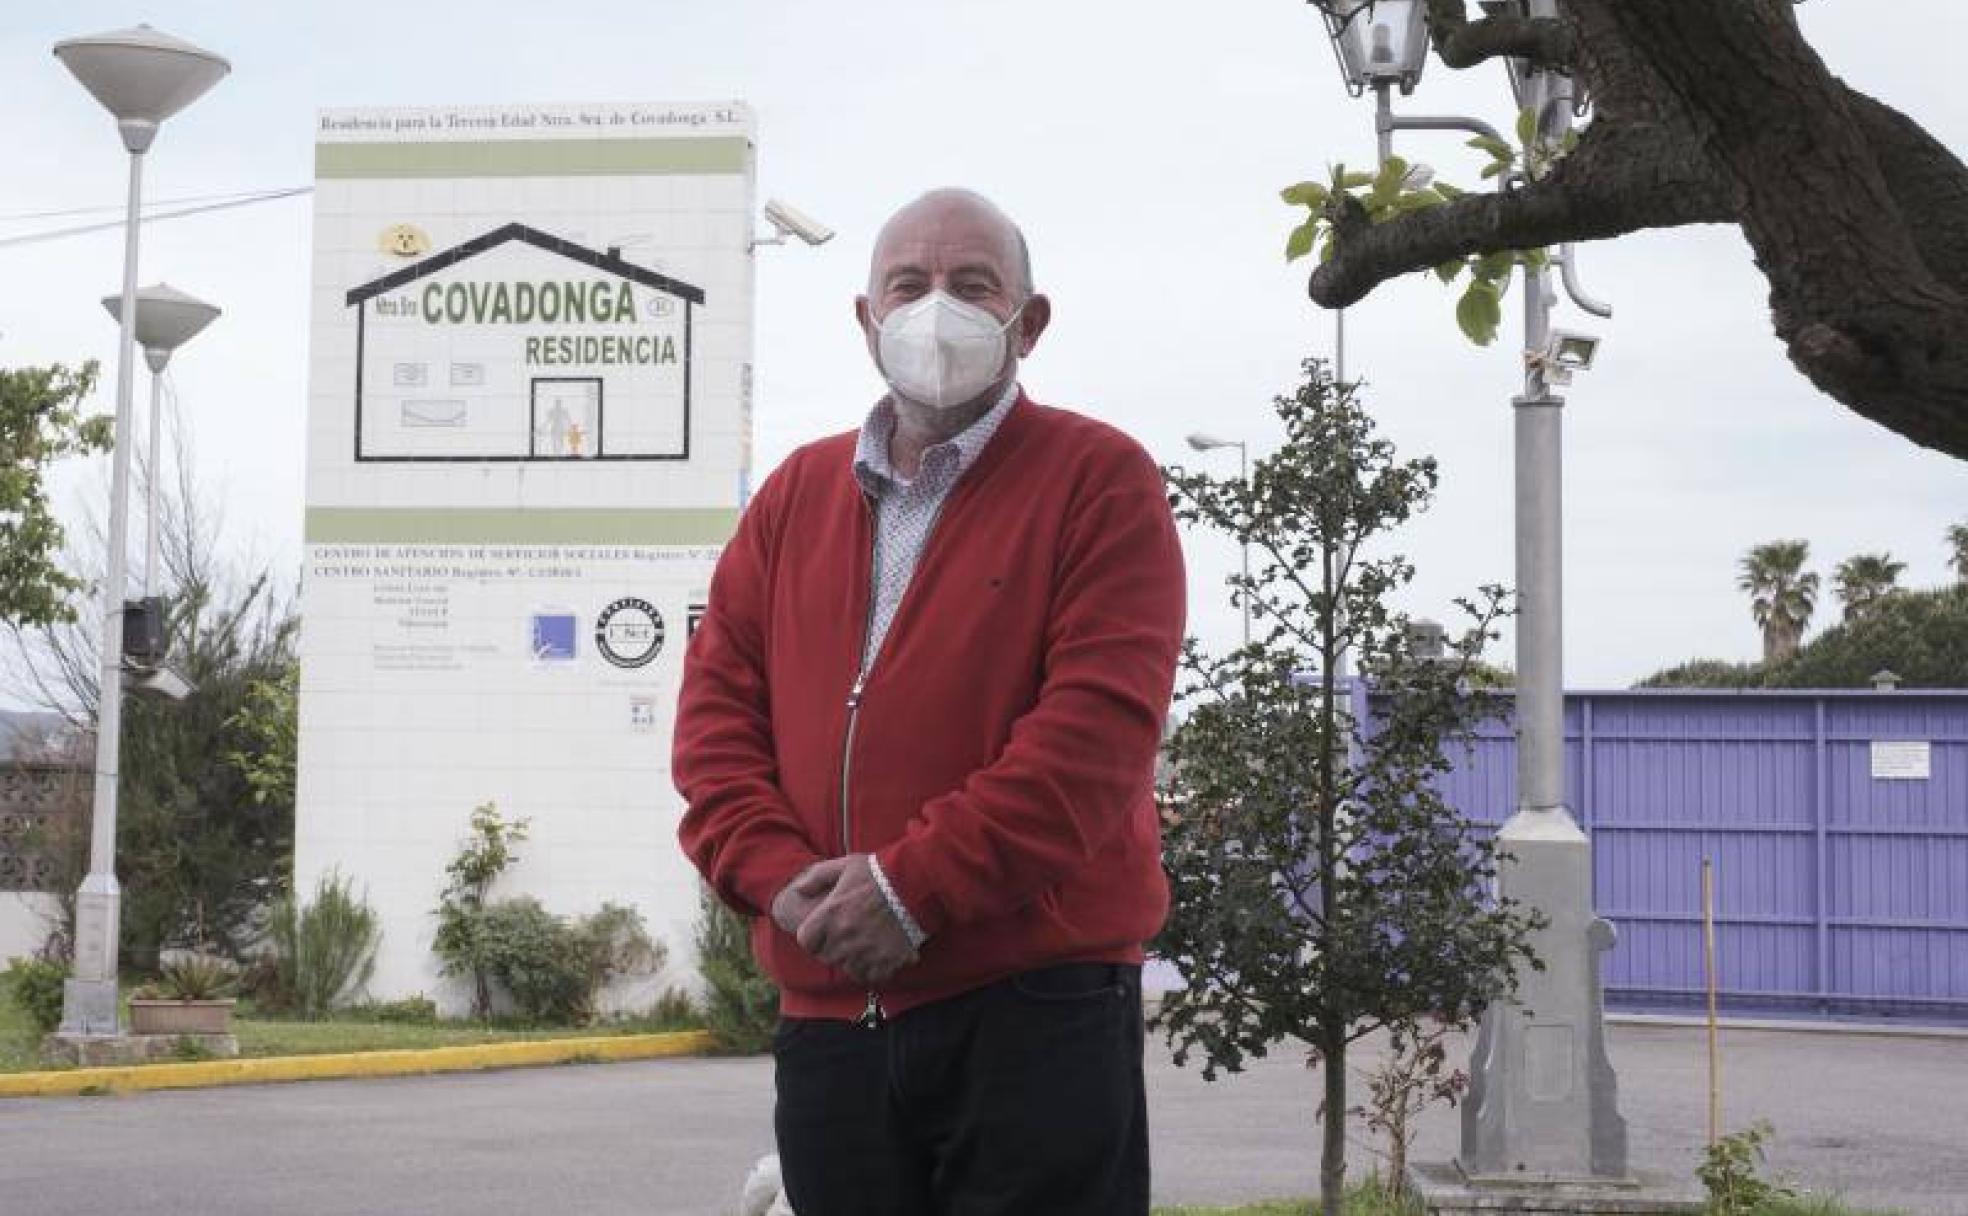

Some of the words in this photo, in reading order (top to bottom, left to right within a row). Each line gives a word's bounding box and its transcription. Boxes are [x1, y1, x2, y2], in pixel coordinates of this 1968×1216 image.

[395, 118, 425, 132] para
[429, 115, 441, 127] la
[609, 111, 625, 125] de
[422, 281, 638, 325] COVADONGA
[525, 335, 678, 365] RESIDENCIA
